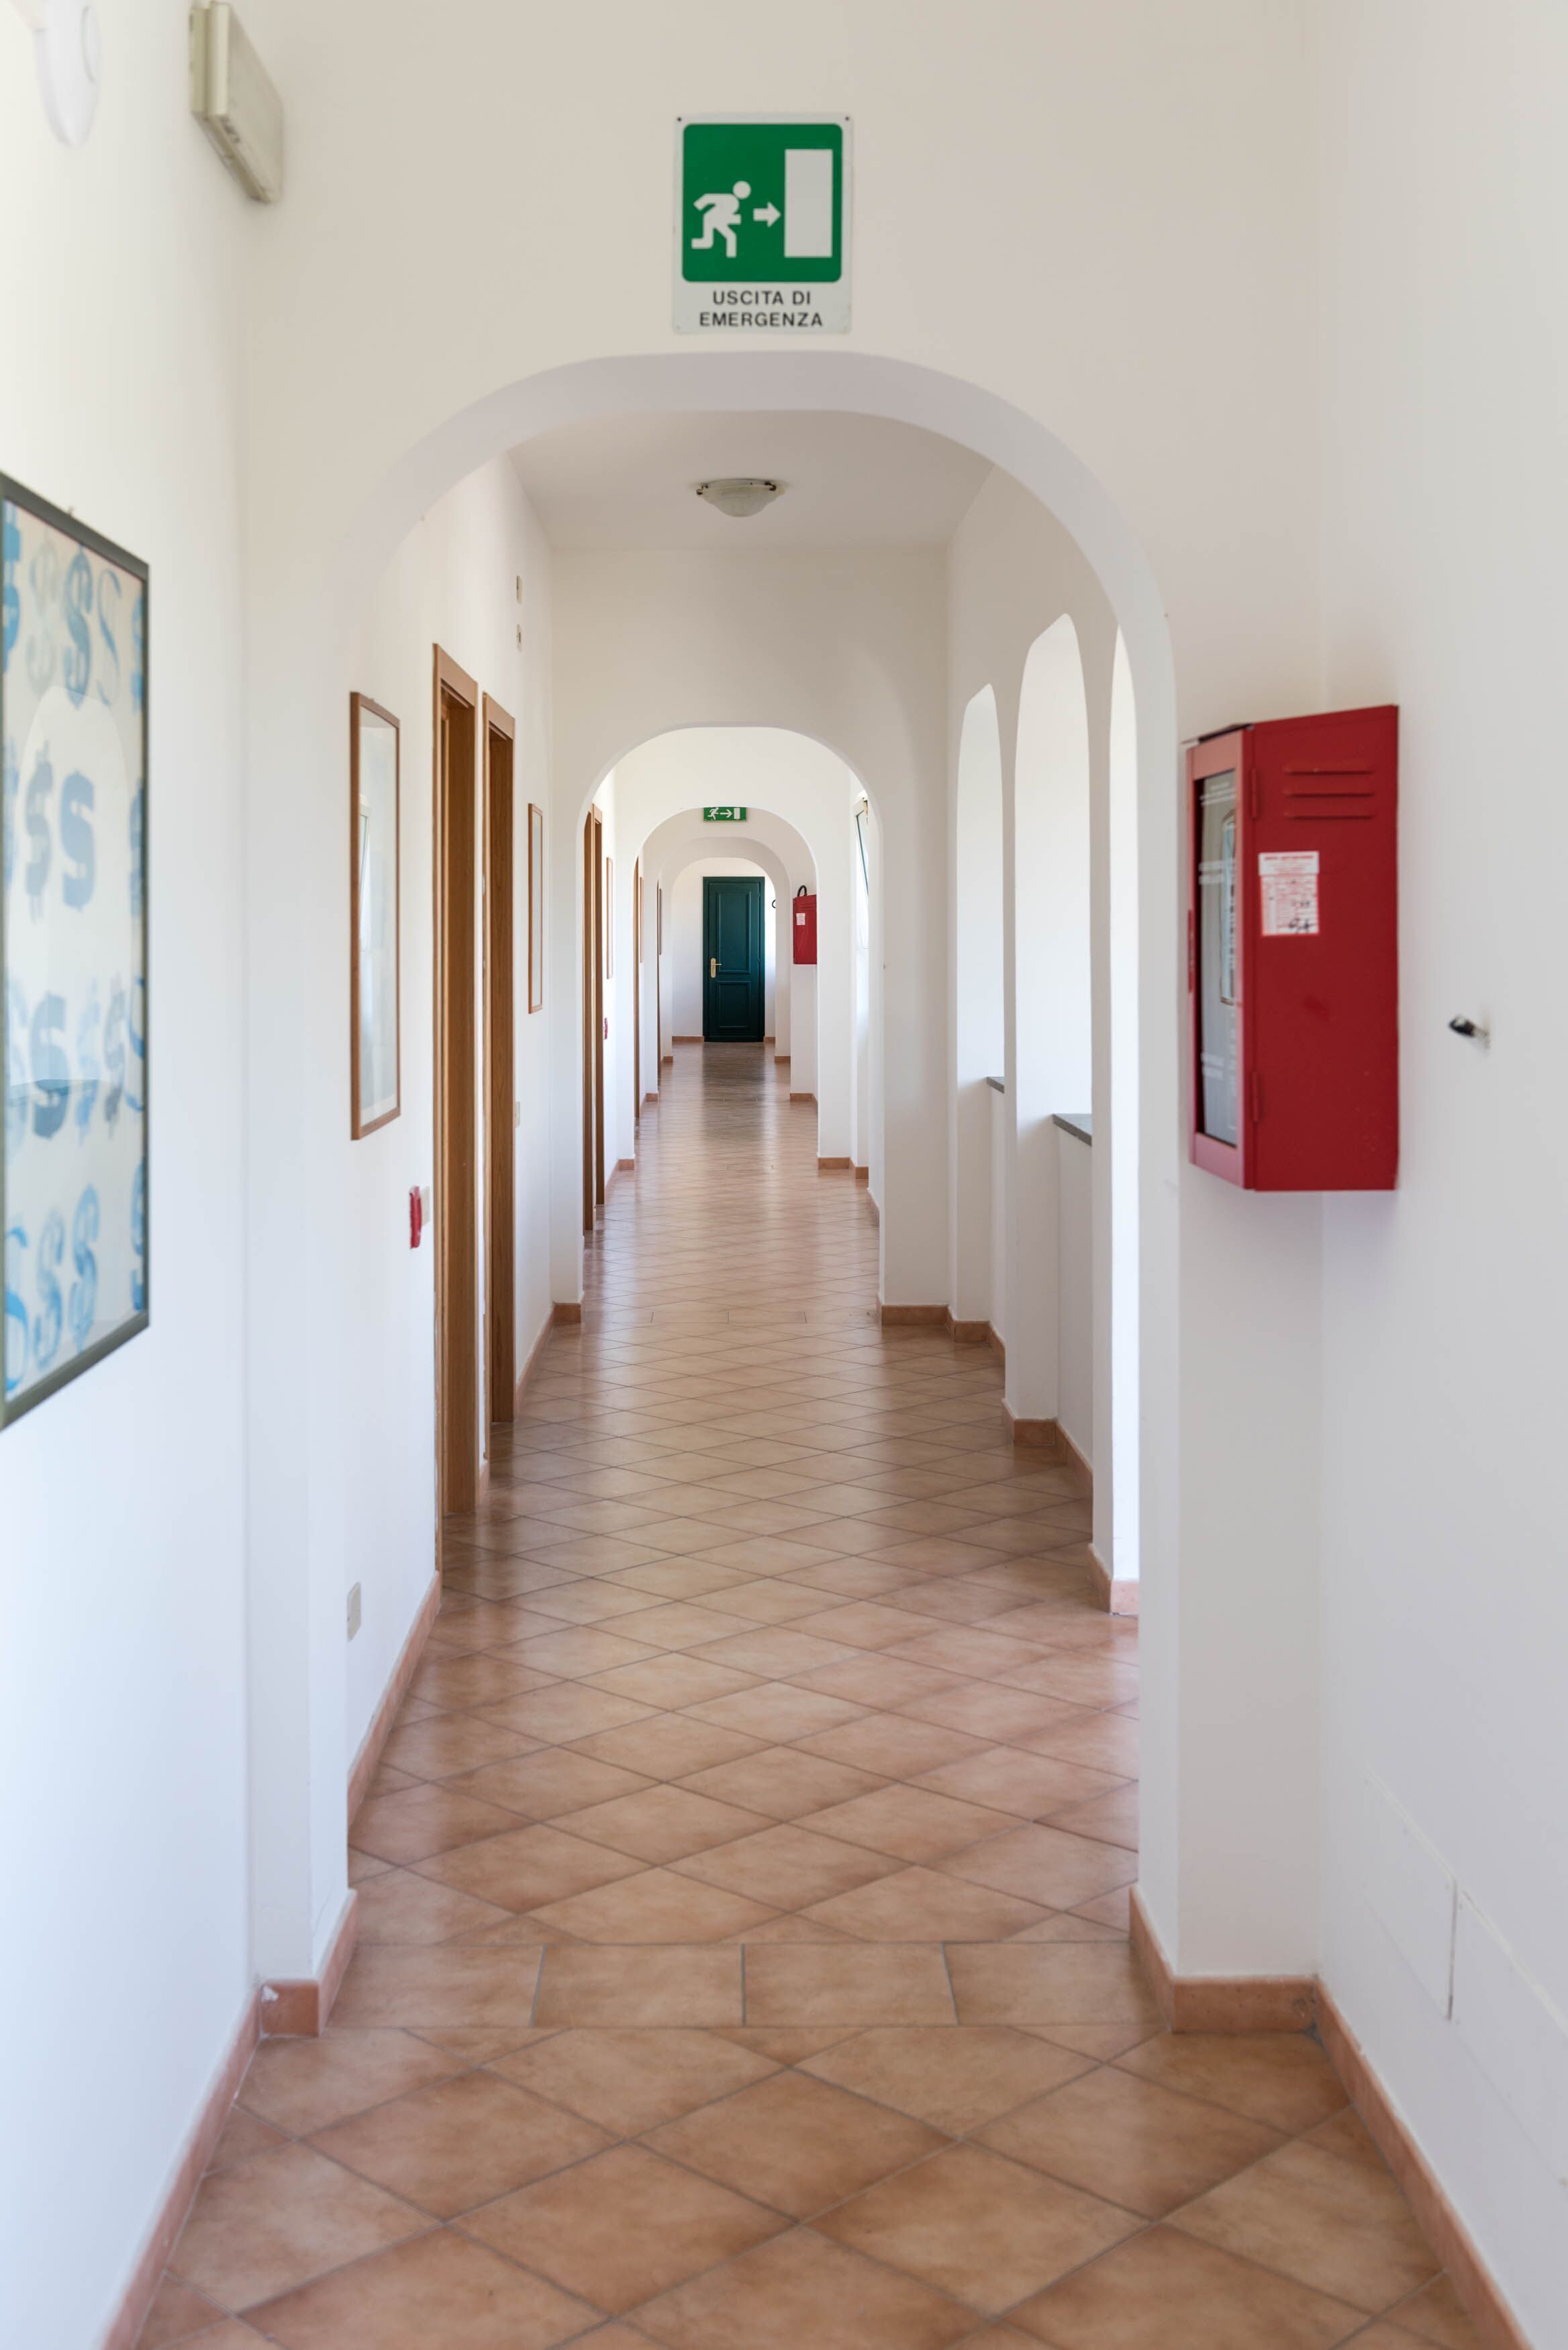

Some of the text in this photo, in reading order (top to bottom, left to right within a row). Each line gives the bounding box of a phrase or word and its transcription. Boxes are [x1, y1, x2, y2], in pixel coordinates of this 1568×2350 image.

[713, 290, 811, 306] USCITA DI
[699, 312, 823, 327] EMERGENZA
